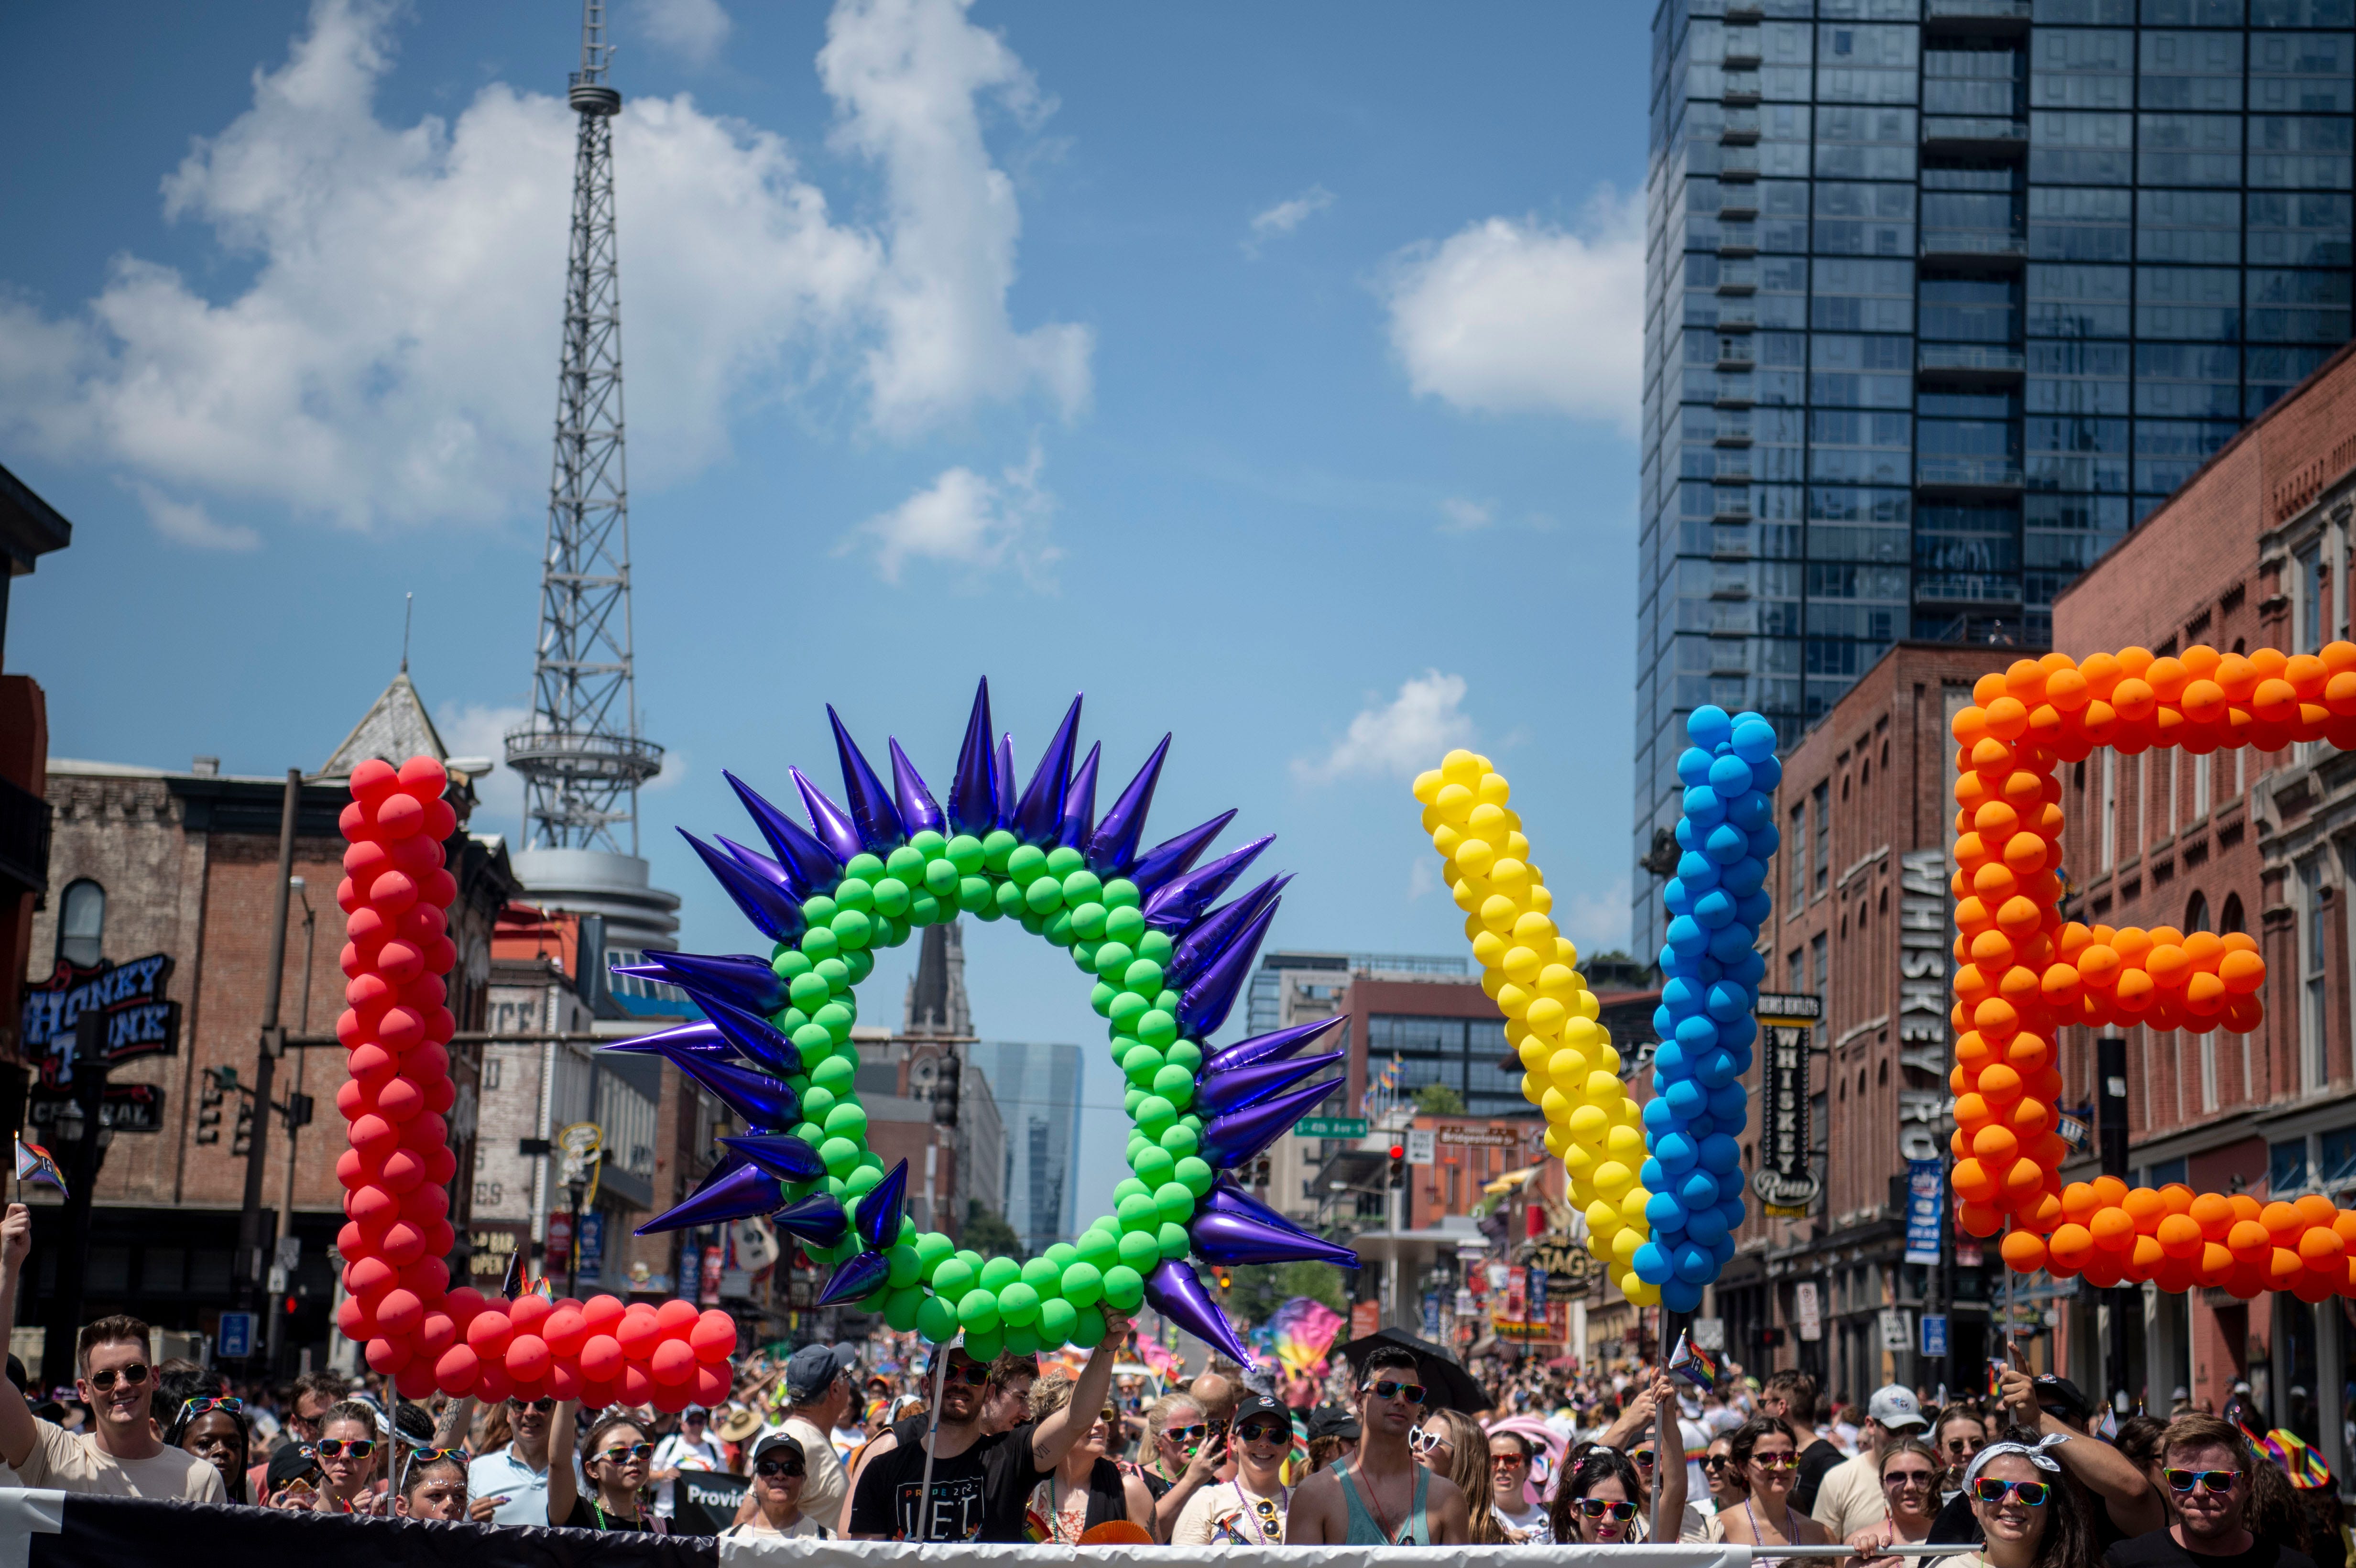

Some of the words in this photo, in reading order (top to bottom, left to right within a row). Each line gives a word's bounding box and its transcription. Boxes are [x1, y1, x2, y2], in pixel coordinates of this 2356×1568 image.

[29, 958, 164, 1044] HONKY
[1900, 849, 1945, 1076] WHISKEY
[50, 1004, 169, 1084] TNK
[1775, 1026, 1800, 1174] WHISKEY
[1753, 1169, 1820, 1206] Row
[905, 1488, 947, 1498] PRDE
